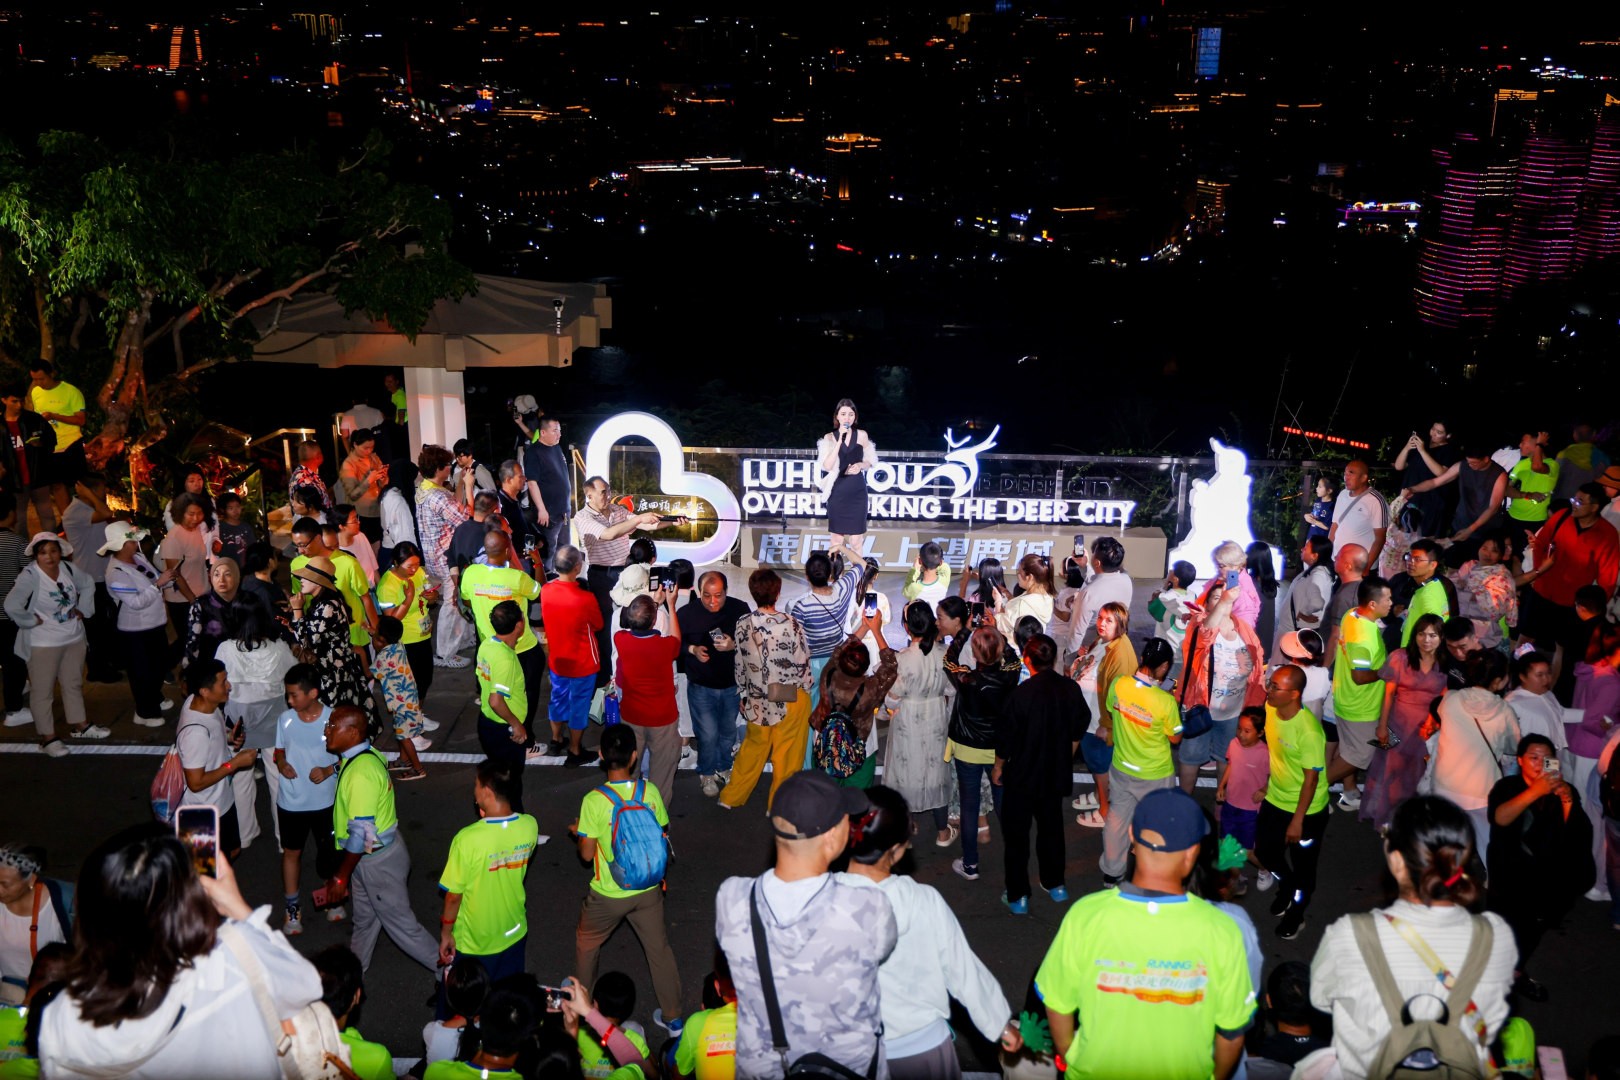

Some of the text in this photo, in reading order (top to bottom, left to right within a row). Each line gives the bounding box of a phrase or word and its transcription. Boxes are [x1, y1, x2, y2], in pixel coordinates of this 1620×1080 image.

[742, 491, 1136, 524] OVERLKING THE DEER CITY
[1147, 959, 1192, 970] RUNNING
